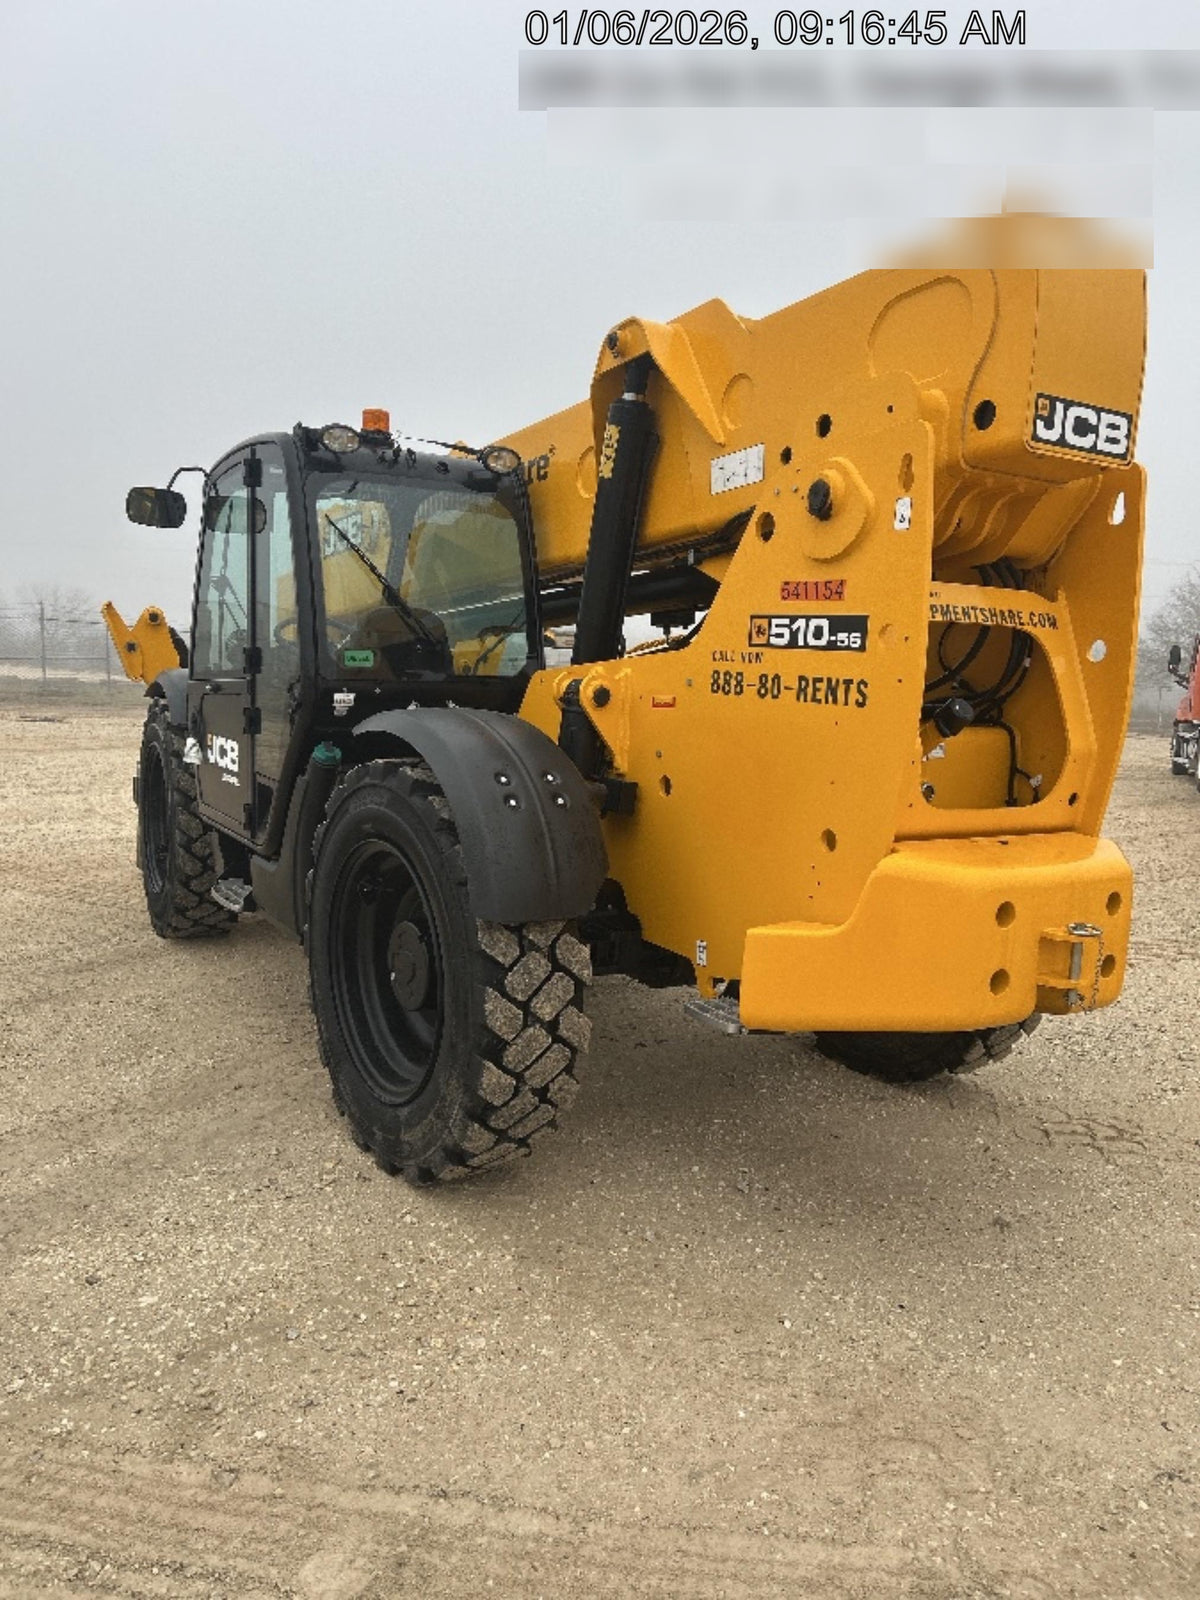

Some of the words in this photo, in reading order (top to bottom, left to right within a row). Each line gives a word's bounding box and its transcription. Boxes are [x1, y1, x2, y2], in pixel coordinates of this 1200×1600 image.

[1036, 401, 1128, 454] JCB
[781, 580, 845, 601] 541154
[769, 617, 862, 648] 510-56
[711, 669, 869, 709] 888-80-RENTS
[207, 733, 239, 772] JCB
